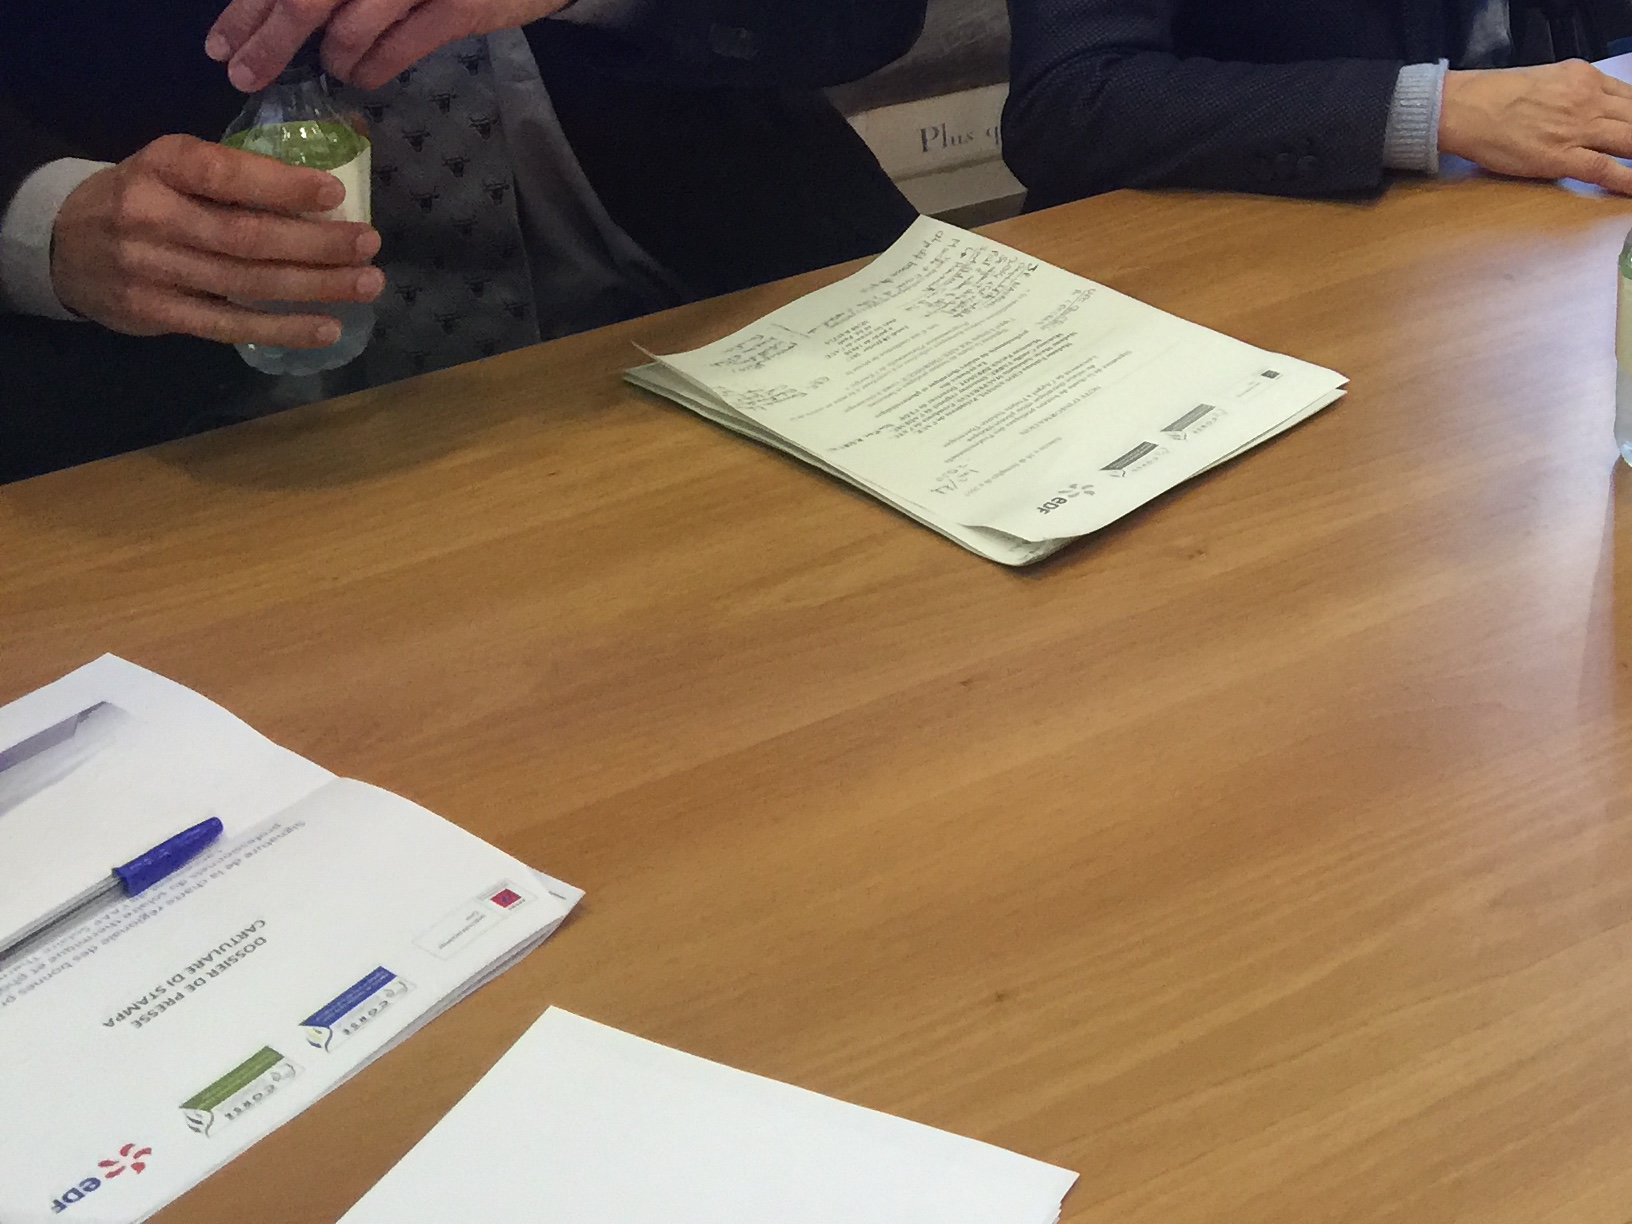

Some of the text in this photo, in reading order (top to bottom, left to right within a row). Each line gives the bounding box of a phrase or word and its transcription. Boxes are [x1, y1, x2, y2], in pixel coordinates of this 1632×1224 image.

[920, 122, 974, 153] Plus
[102, 919, 266, 1028] CARTULARE DI STAMPA
[130, 936, 267, 1028] DOSSIER DE PRESSE
